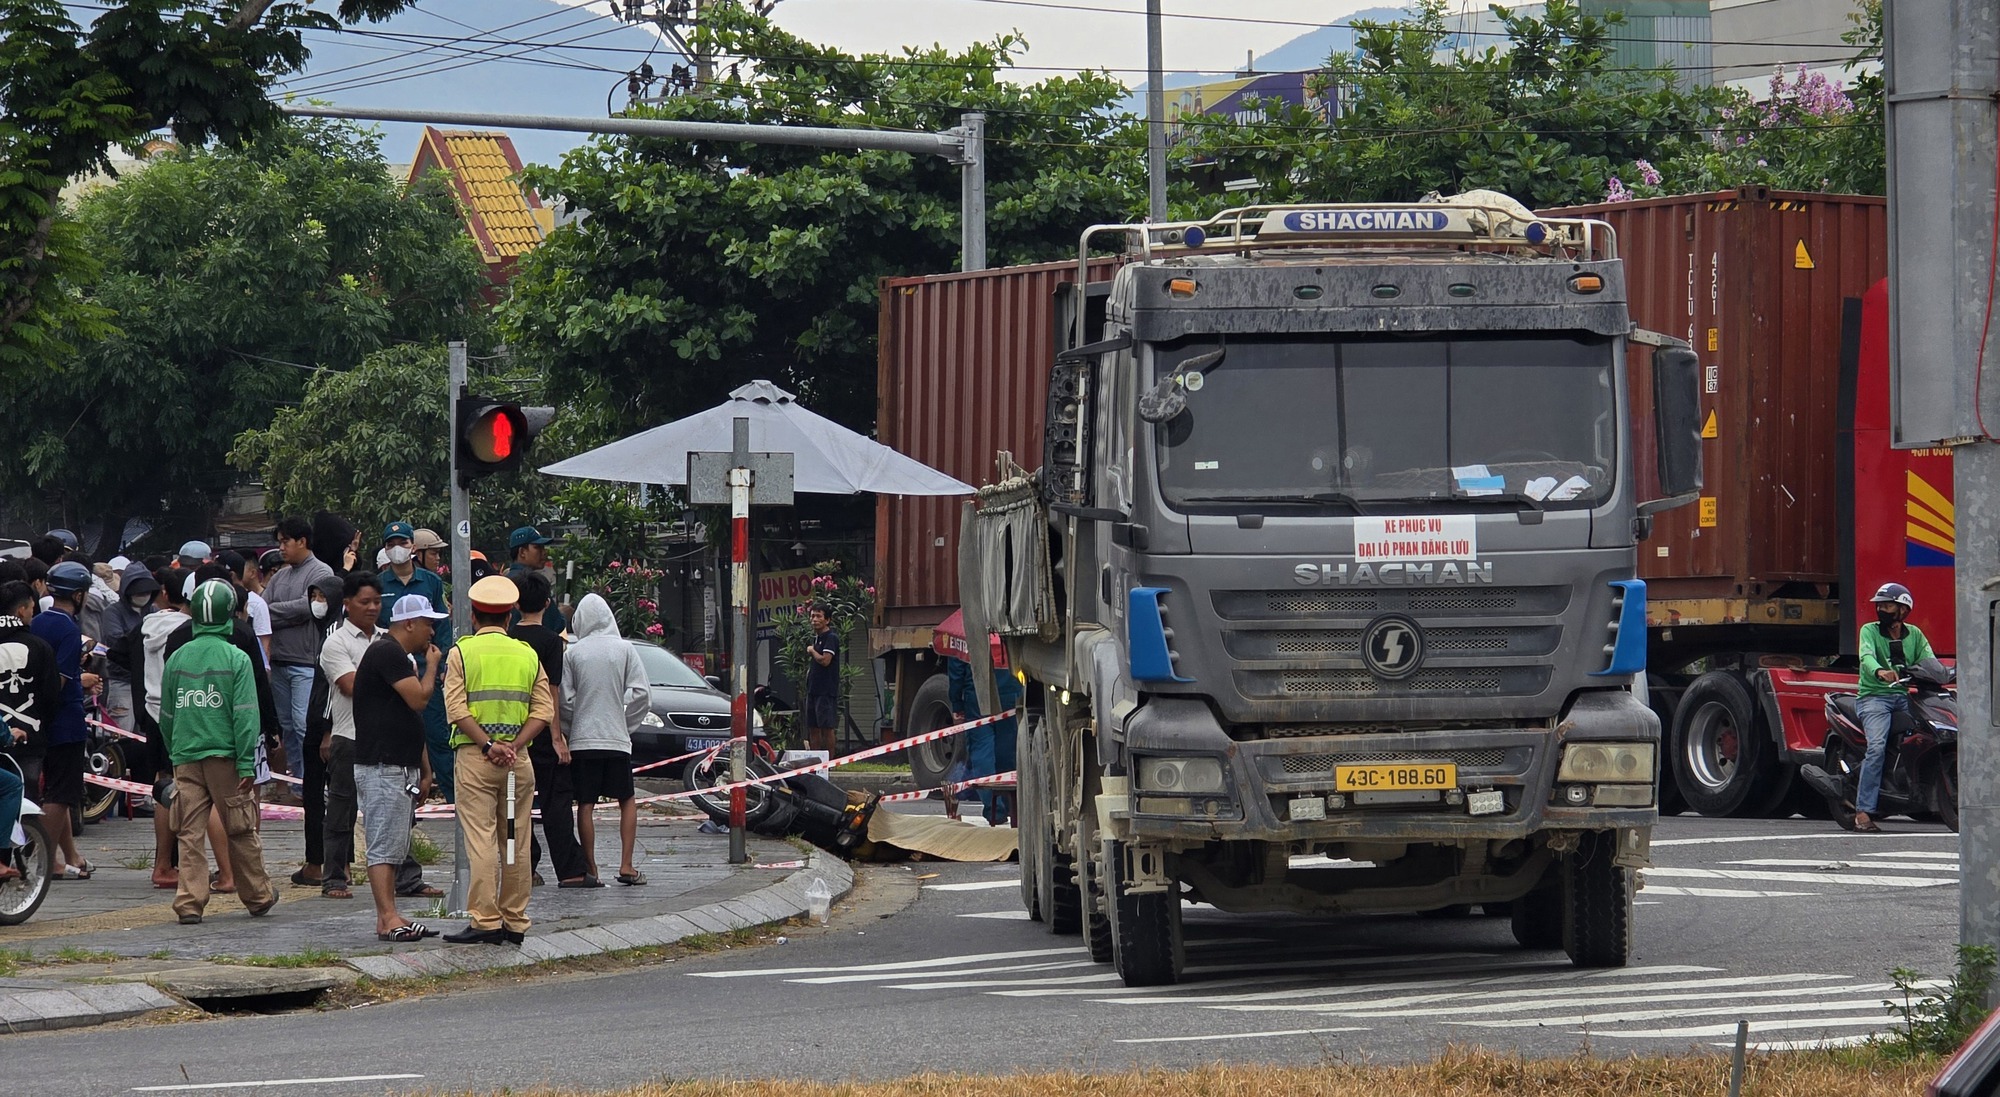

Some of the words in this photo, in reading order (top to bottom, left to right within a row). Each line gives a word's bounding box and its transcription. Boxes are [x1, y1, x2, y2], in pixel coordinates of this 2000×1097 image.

[1299, 212, 1434, 230] SHACMAN
[460, 521, 468, 534] 4
[1385, 520, 1396, 533] XE
[1399, 519, 1426, 535] PHỤC
[1428, 519, 1441, 535] VỤ
[1358, 542, 1375, 559] ĐẠI
[1378, 540, 1389, 559] LỘ
[1393, 541, 1418, 556] PHAN
[1421, 538, 1448, 555] ĐĂNG
[1451, 538, 1469, 554] LƯU
[1293, 562, 1493, 585] SHACMAN
[1347, 769, 1446, 786] 43C-188.60
